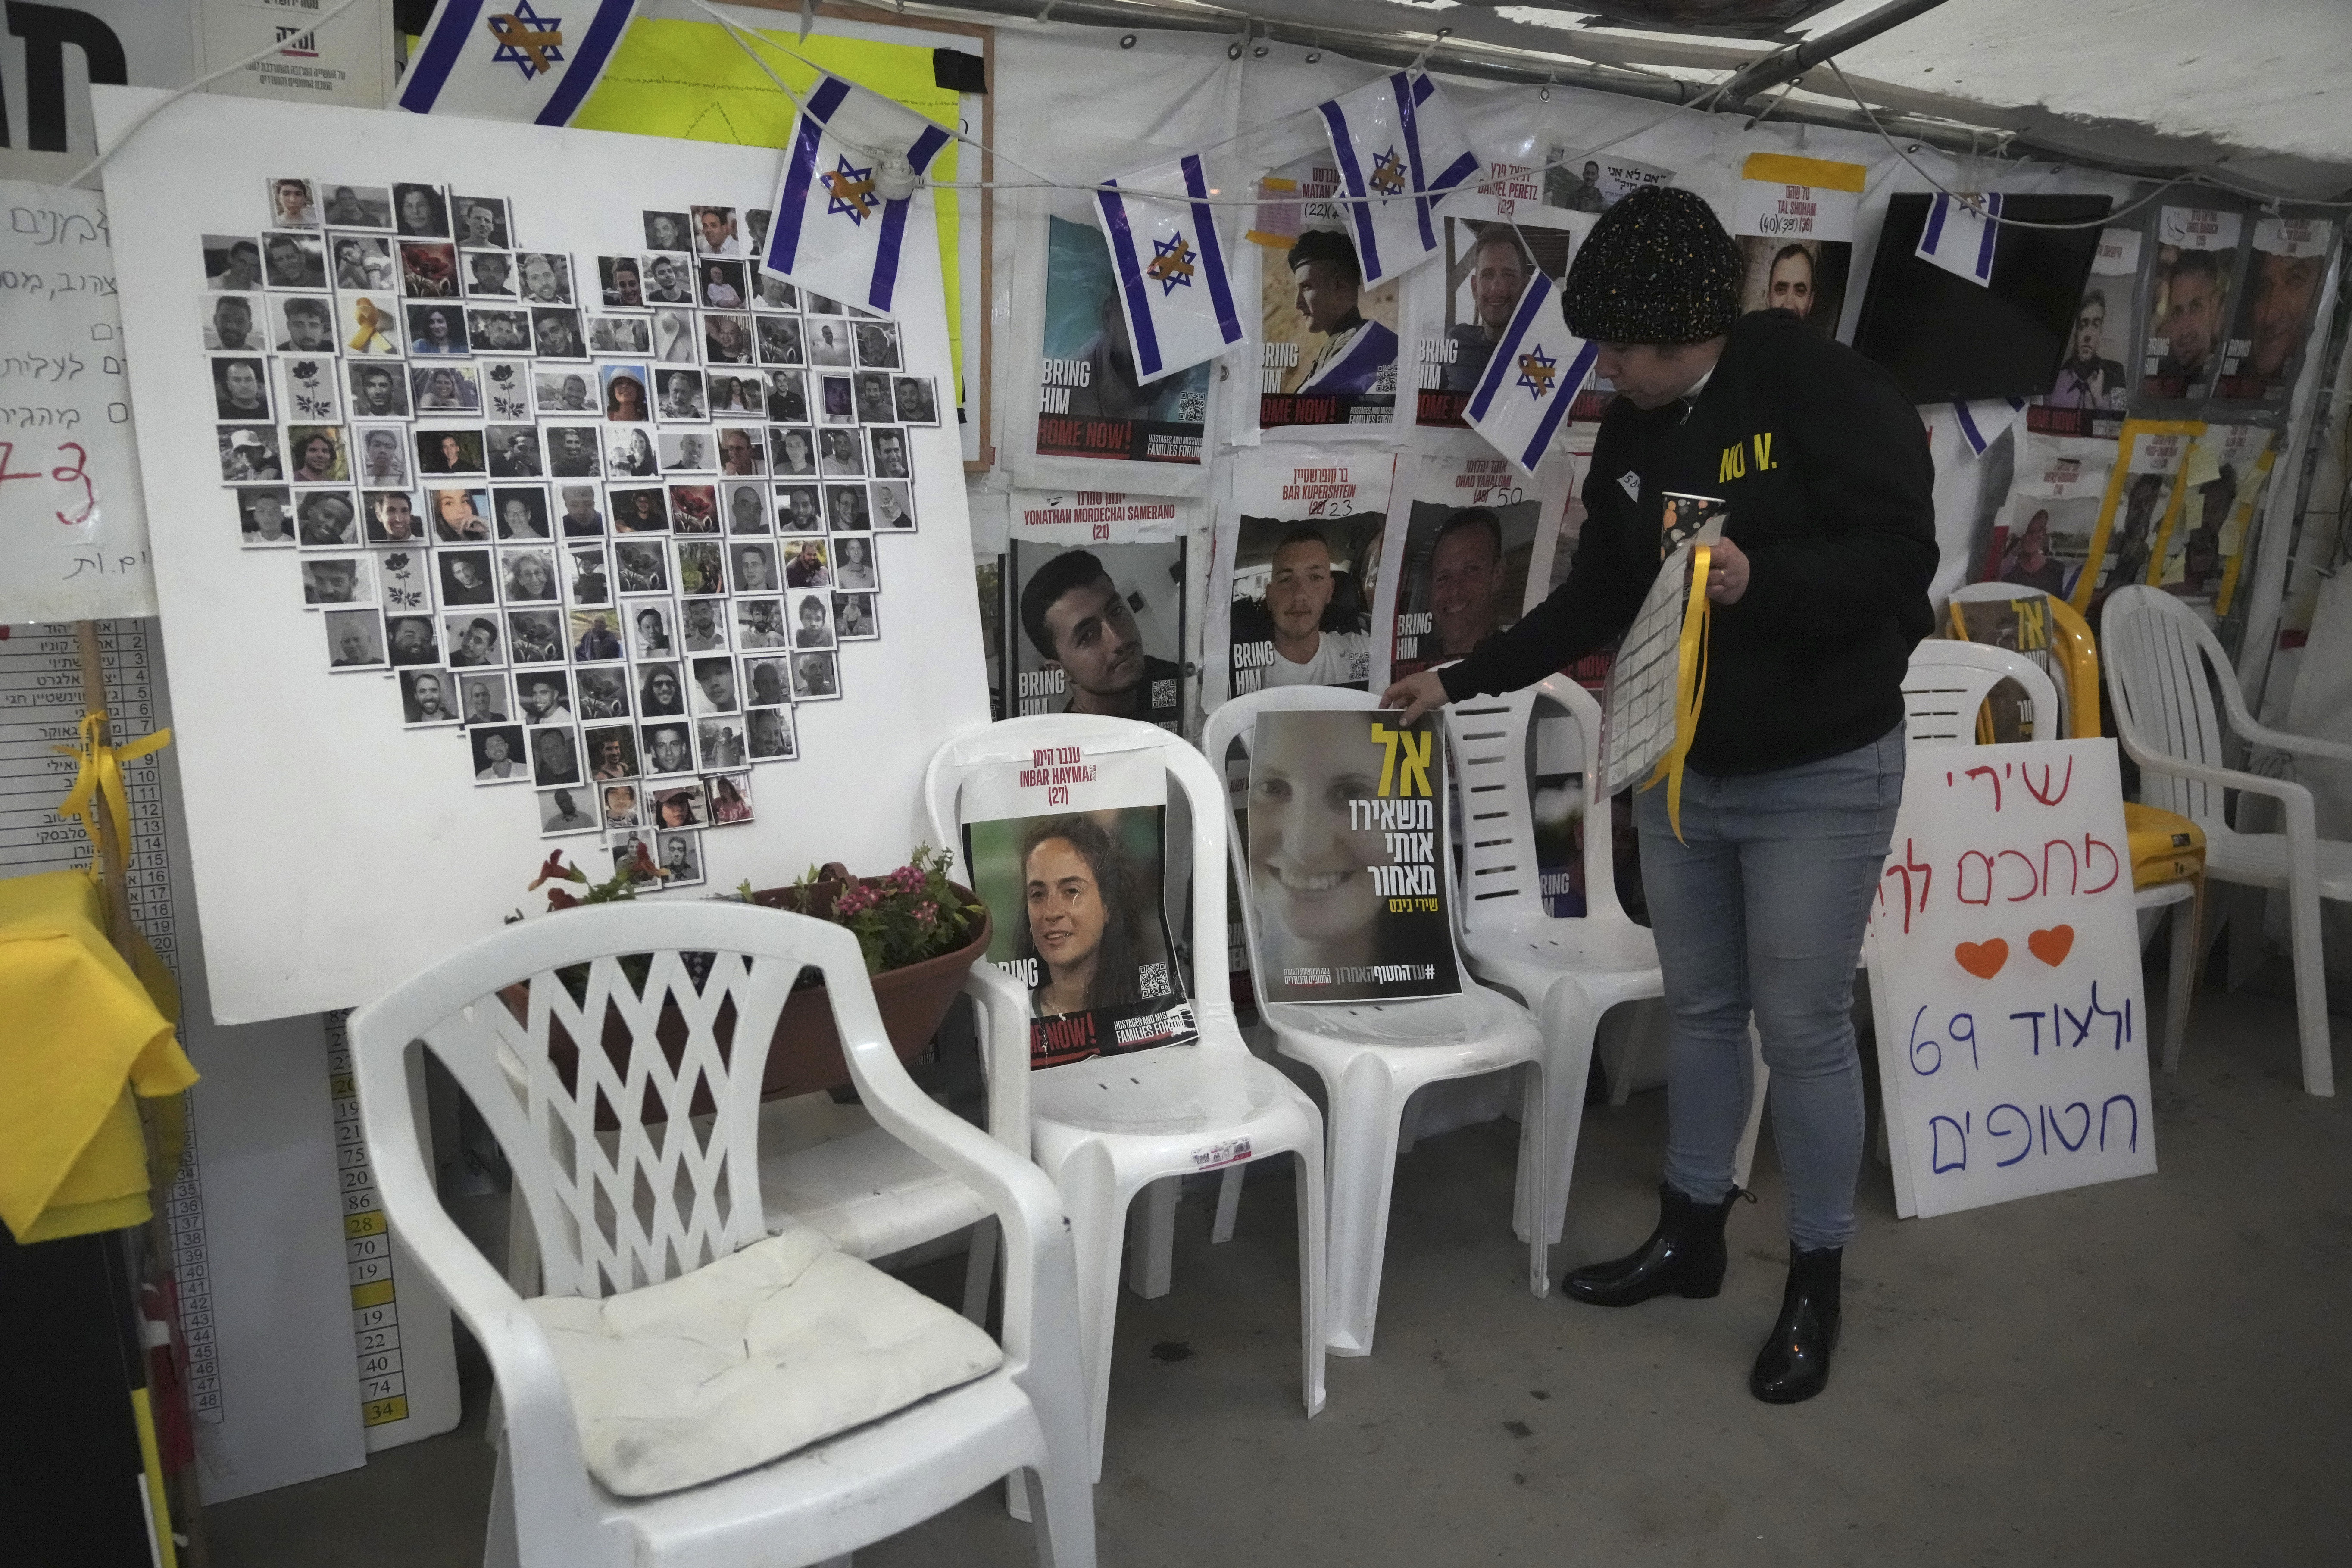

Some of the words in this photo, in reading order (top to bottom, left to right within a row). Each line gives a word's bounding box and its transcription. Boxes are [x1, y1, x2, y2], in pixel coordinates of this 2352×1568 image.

[1303, 183, 1330, 198] MATAN
[1478, 181, 1506, 197] DANEL
[1509, 182, 1537, 200] PERETZ
[1777, 200, 1788, 214] TAL
[1263, 343, 1299, 367] RING
[1043, 358, 1090, 387] BRING
[1263, 369, 1282, 393] IM
[1041, 387, 1070, 414] HIM
[1261, 398, 1292, 422] OME
[1038, 418, 1083, 447] HOME
[1086, 420, 1132, 450] NOW!
[1149, 434, 1172, 444] HOSTAGES
[1173, 435, 1182, 445] AND
[1147, 444, 1178, 457] FAMILIES
[1178, 446, 1202, 459] FORUM
[1294, 468, 1337, 484] קופרשטיין
[1339, 468, 1348, 482] בר
[1456, 475, 1475, 488] OHAD
[1477, 475, 1512, 488] YAHALOMI
[1282, 485, 1300, 500] BAR
[1302, 484, 1356, 500] KUPERSHTEIN
[1497, 487, 1523, 508] 50
[1024, 509, 1072, 525] YONATHAN
[1074, 506, 1125, 523] MORDECHAI
[1128, 504, 1175, 521] SAMERANO
[1329, 499, 1352, 516] 23
[1093, 523, 1109, 540] (21)
[132, 619, 138, 631] 1
[1397, 612, 1433, 636] BRING
[133, 636, 141, 648] 2
[1396, 637, 1418, 660] HIM
[135, 653, 143, 665] 3
[1233, 640, 1274, 668] BRING
[136, 669, 144, 681] 4
[1019, 669, 1065, 697] BRING
[1235, 668, 1262, 696] HIM
[138, 687, 147, 698] 5
[140, 703, 148, 715] 6
[1019, 698, 1048, 716] HIM
[141, 720, 149, 731] 7
[144, 753, 153, 765] 9
[1033, 749, 1054, 768] הימן
[1056, 747, 1080, 764] ענבר
[1371, 722, 1433, 797] אל
[137, 770, 155, 782] 10
[1020, 768, 1049, 787] INBAR
[1946, 754, 2072, 812] שירי
[140, 787, 155, 799] 11
[1048, 785, 1069, 806] (27)
[142, 804, 158, 816] 12
[1349, 799, 1433, 831] תשאירו
[144, 821, 160, 833] 13
[37, 827, 87, 844] סלבסקי
[145, 837, 161, 850] 14
[1384, 831, 1435, 863] אותי
[147, 854, 163, 866] 15
[148, 870, 166, 883] 16
[1957, 832, 2118, 906] מחכים
[1367, 865, 1437, 896] מאחור
[1540, 872, 1570, 896] RING
[150, 887, 166, 900] 17
[151, 904, 169, 917] 18
[1388, 898, 1414, 913] ביבס
[1415, 898, 1439, 912] שירי
[153, 920, 170, 932] 19
[153, 937, 172, 950] 20
[1114, 1016, 1142, 1031] HOSTAGES
[1143, 1014, 1155, 1025] AND
[2009, 980, 2131, 1056] ולעוד
[333, 1032, 346, 1047] 2
[1046, 1012, 1096, 1051] NOW!
[1115, 1025, 1154, 1044] FAMILIES
[1909, 1005, 1979, 1076] 69
[340, 1102, 359, 1117] 19
[341, 1125, 360, 1140] 21
[1928, 1094, 2137, 1174] חטופים
[345, 1147, 364, 1163] 75
[347, 1171, 368, 1187] 20
[180, 1200, 198, 1213] 36
[348, 1194, 370, 1210] 86
[182, 1217, 199, 1229] 37
[351, 1217, 373, 1233] 28
[184, 1233, 201, 1246] 38
[185, 1249, 203, 1262] 39
[354, 1240, 375, 1256] 70
[187, 1265, 204, 1278] 40
[358, 1264, 378, 1280] 19
[188, 1281, 204, 1293] 41
[190, 1298, 207, 1310] 42
[192, 1314, 209, 1327] 43
[363, 1310, 383, 1326] 19
[193, 1330, 211, 1342] 44
[364, 1334, 385, 1350] 22
[195, 1346, 212, 1359] 45
[197, 1362, 214, 1374] 46
[366, 1356, 388, 1373] 40
[198, 1378, 215, 1390] 47
[370, 1380, 391, 1397] 74
[200, 1394, 216, 1407] 48
[372, 1402, 393, 1420] 34
